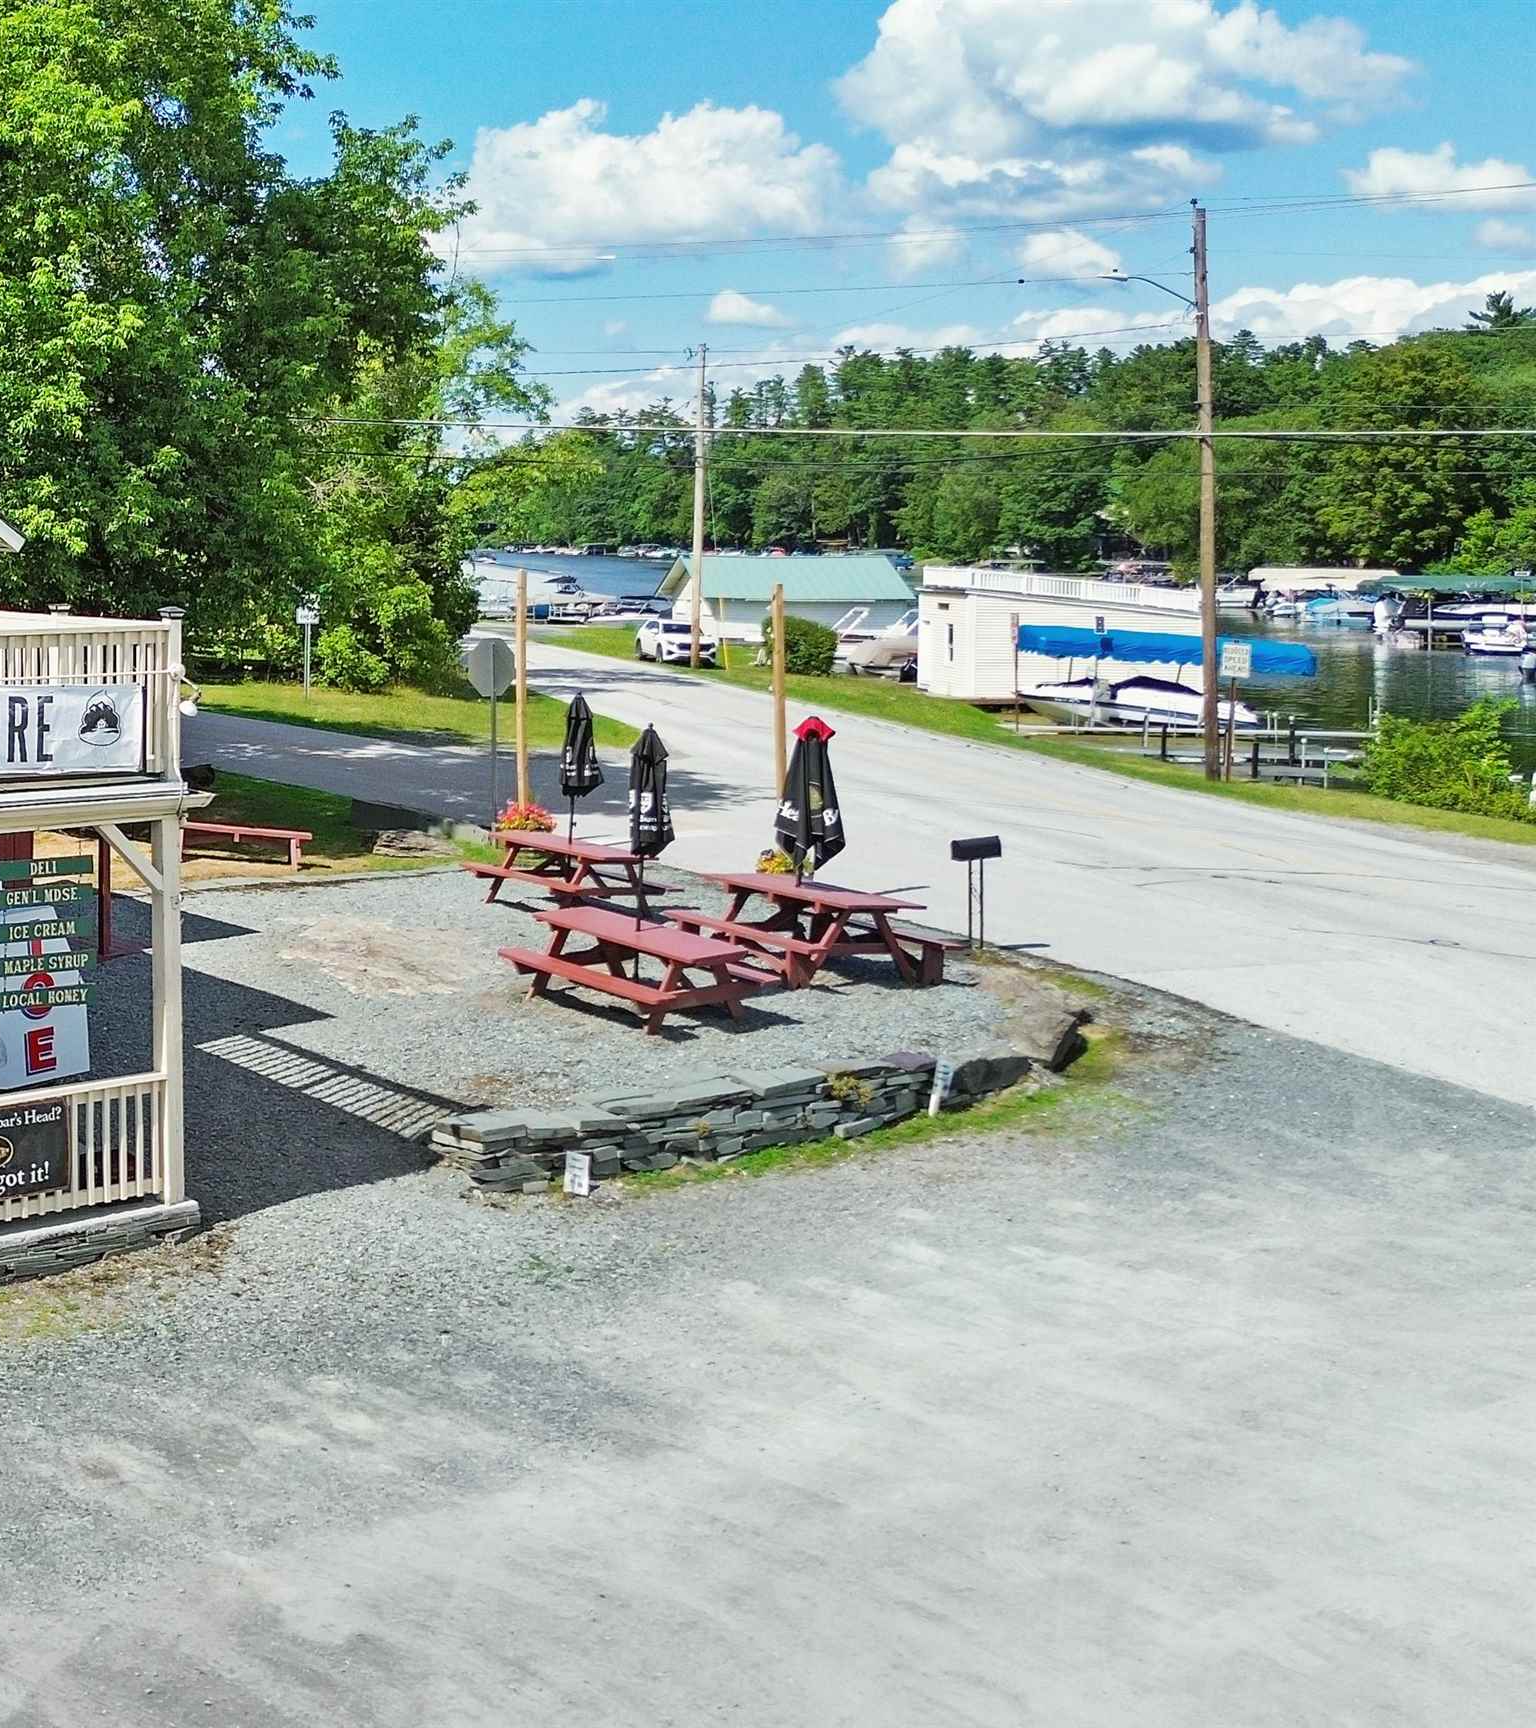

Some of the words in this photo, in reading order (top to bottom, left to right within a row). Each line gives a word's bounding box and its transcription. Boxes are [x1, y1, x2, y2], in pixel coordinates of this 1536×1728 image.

[30, 860, 57, 876] DELI
[8, 925, 30, 940] ICE
[33, 920, 76, 937] CREAM
[4, 957, 44, 974] MAPLE
[48, 953, 89, 970] SYRUP
[2, 992, 43, 1008] LOCAL
[48, 988, 89, 1004] HONEY
[24, 1106, 62, 1124] Head?
[29, 1160, 50, 1184] it!
